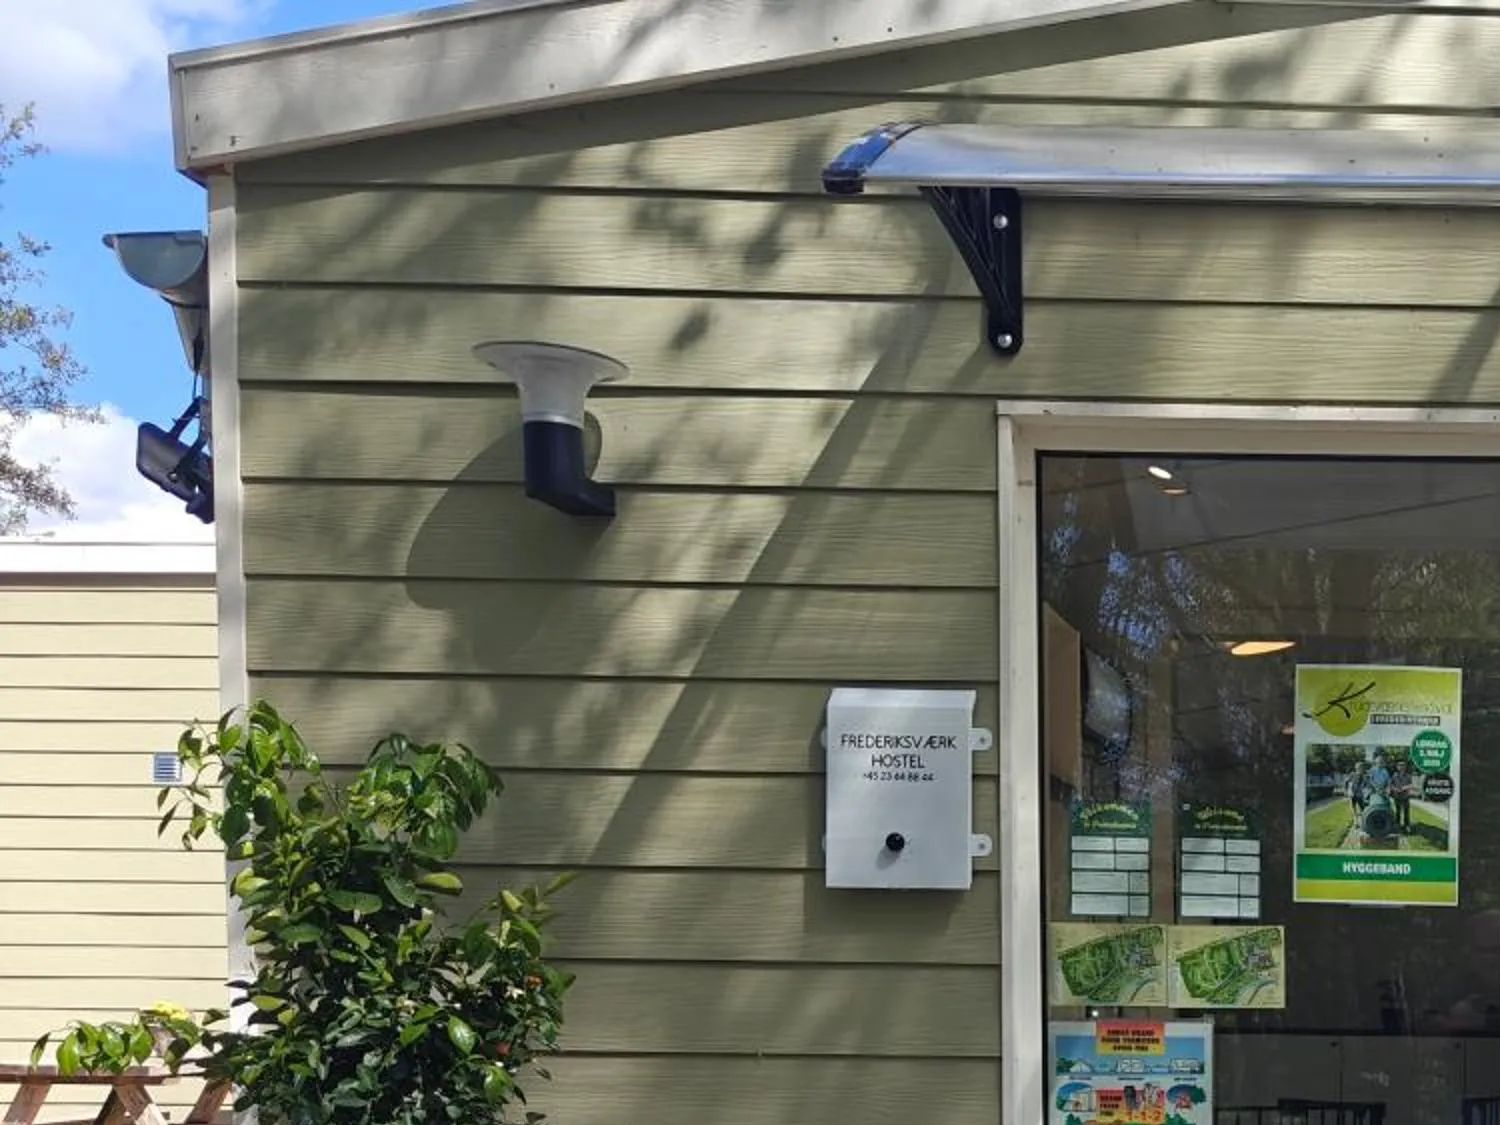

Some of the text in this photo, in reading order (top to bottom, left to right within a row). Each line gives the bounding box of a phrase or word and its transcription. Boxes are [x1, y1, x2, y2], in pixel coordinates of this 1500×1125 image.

[840, 733, 957, 750] FREDERIKSVÆRK
[871, 753, 925, 769] HOSTEL
[1343, 861, 1411, 875] HYGGEBAND
